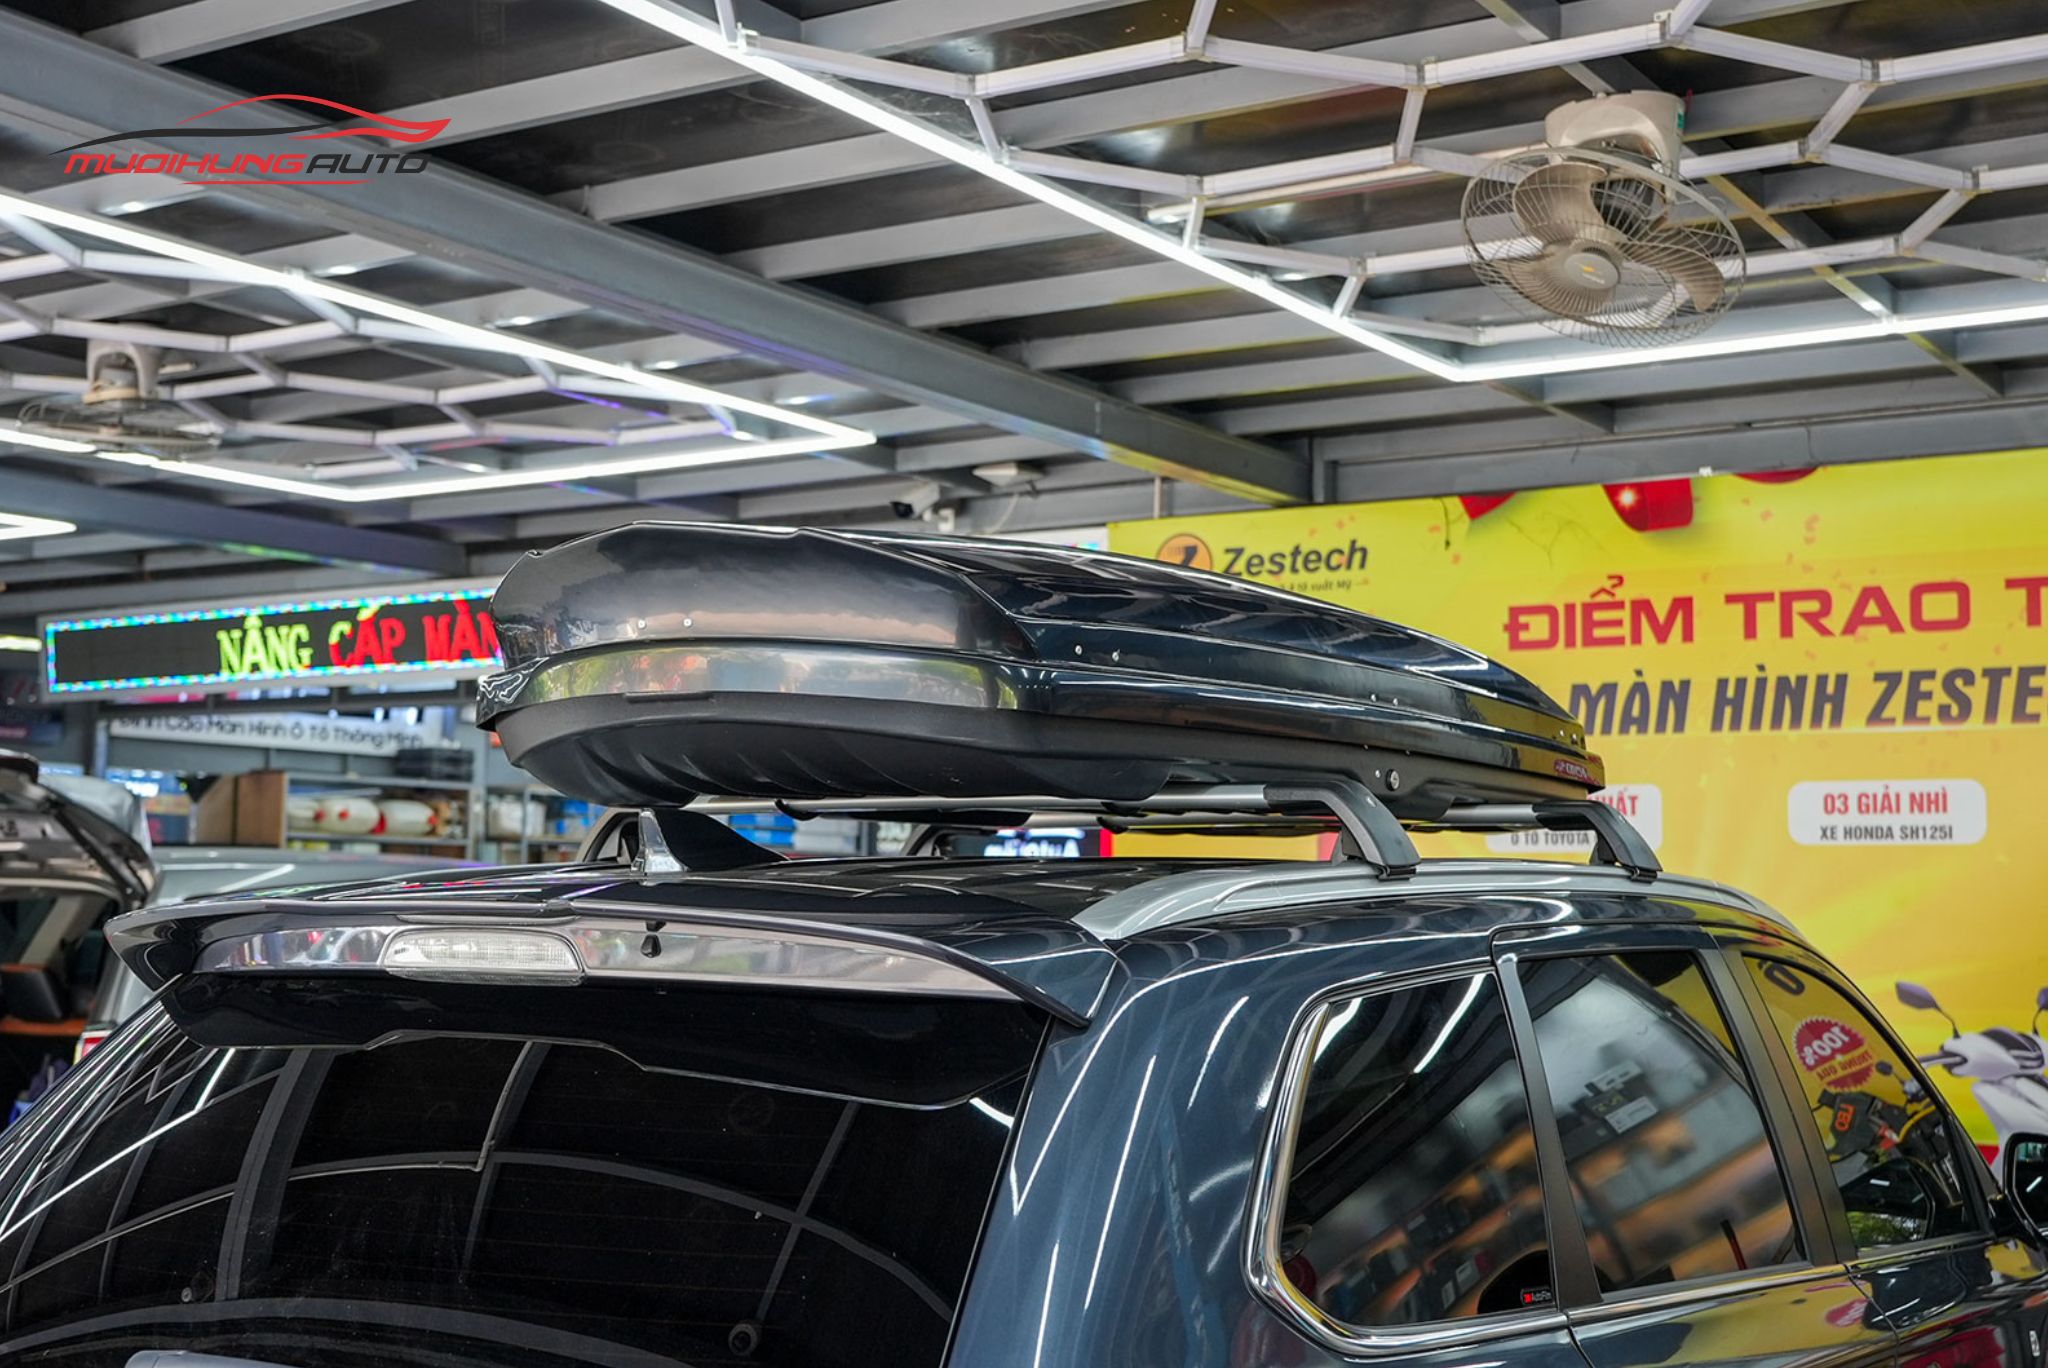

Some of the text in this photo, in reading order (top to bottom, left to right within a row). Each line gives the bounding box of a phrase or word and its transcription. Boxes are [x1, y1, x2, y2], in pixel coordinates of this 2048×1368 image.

[1222, 539, 1368, 577] Zestech
[1502, 574, 1694, 652] ĐIỂM
[1725, 581, 1971, 641] TRAO
[216, 616, 313, 674] NÂNG
[329, 605, 406, 668] CẤP
[1570, 664, 2047, 736] MÀN HÌNH ZESTE
[1823, 784, 1948, 815] 03 GIẢI NHÌ
[1544, 832, 1590, 846] TOYOTA
[1820, 825, 1837, 841] XE
[1843, 825, 1894, 841] HONDA
